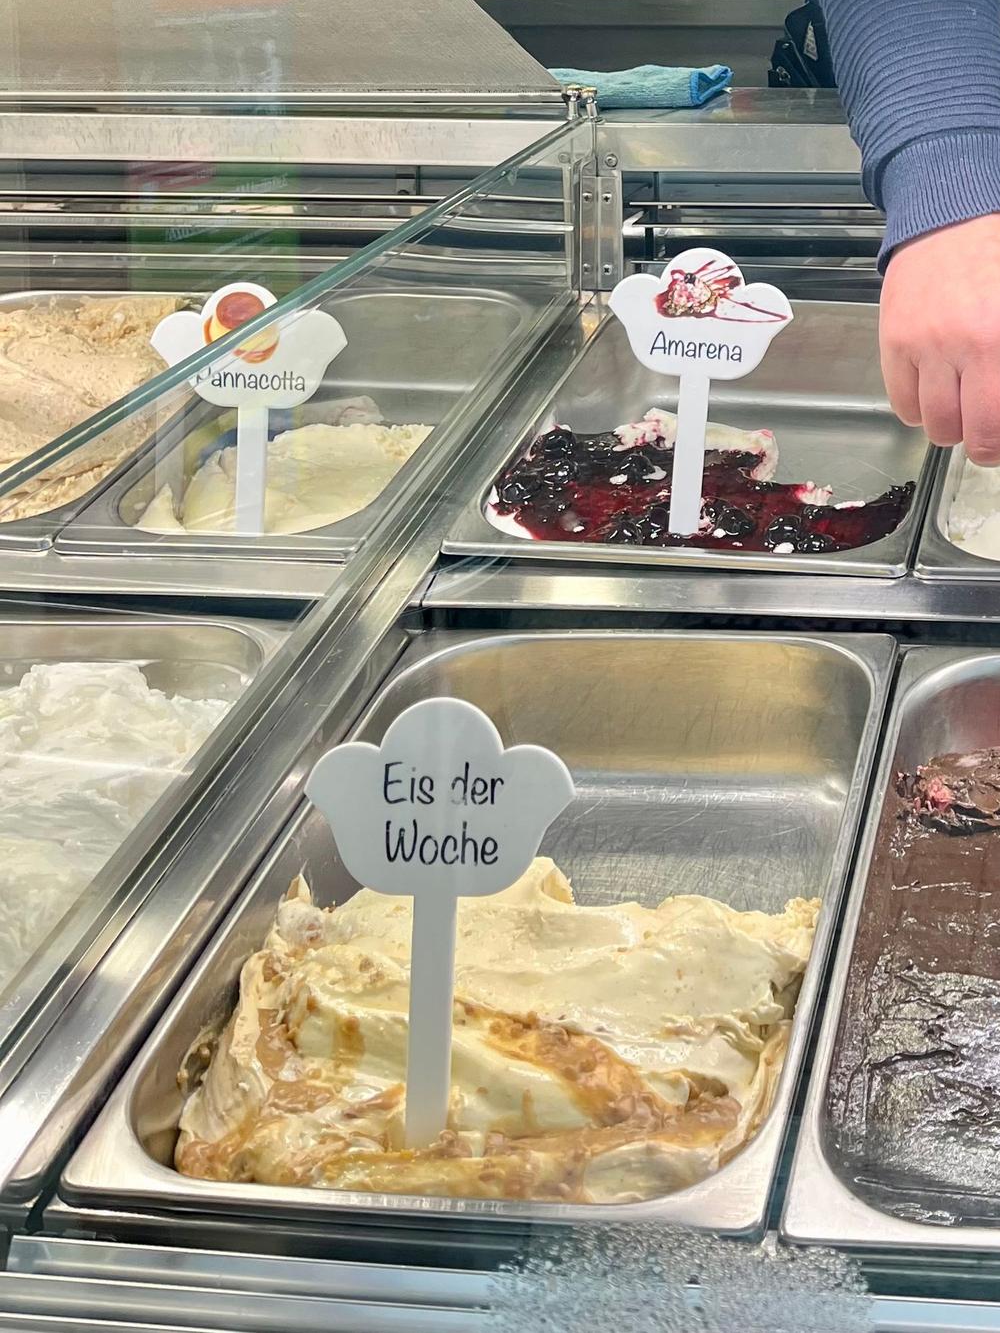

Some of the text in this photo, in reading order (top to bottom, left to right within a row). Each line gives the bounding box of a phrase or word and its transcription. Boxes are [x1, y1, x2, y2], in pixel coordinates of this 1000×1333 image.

[649, 330, 742, 363] Amarena
[383, 761, 504, 805] Eis der
[385, 819, 499, 866] Woche
